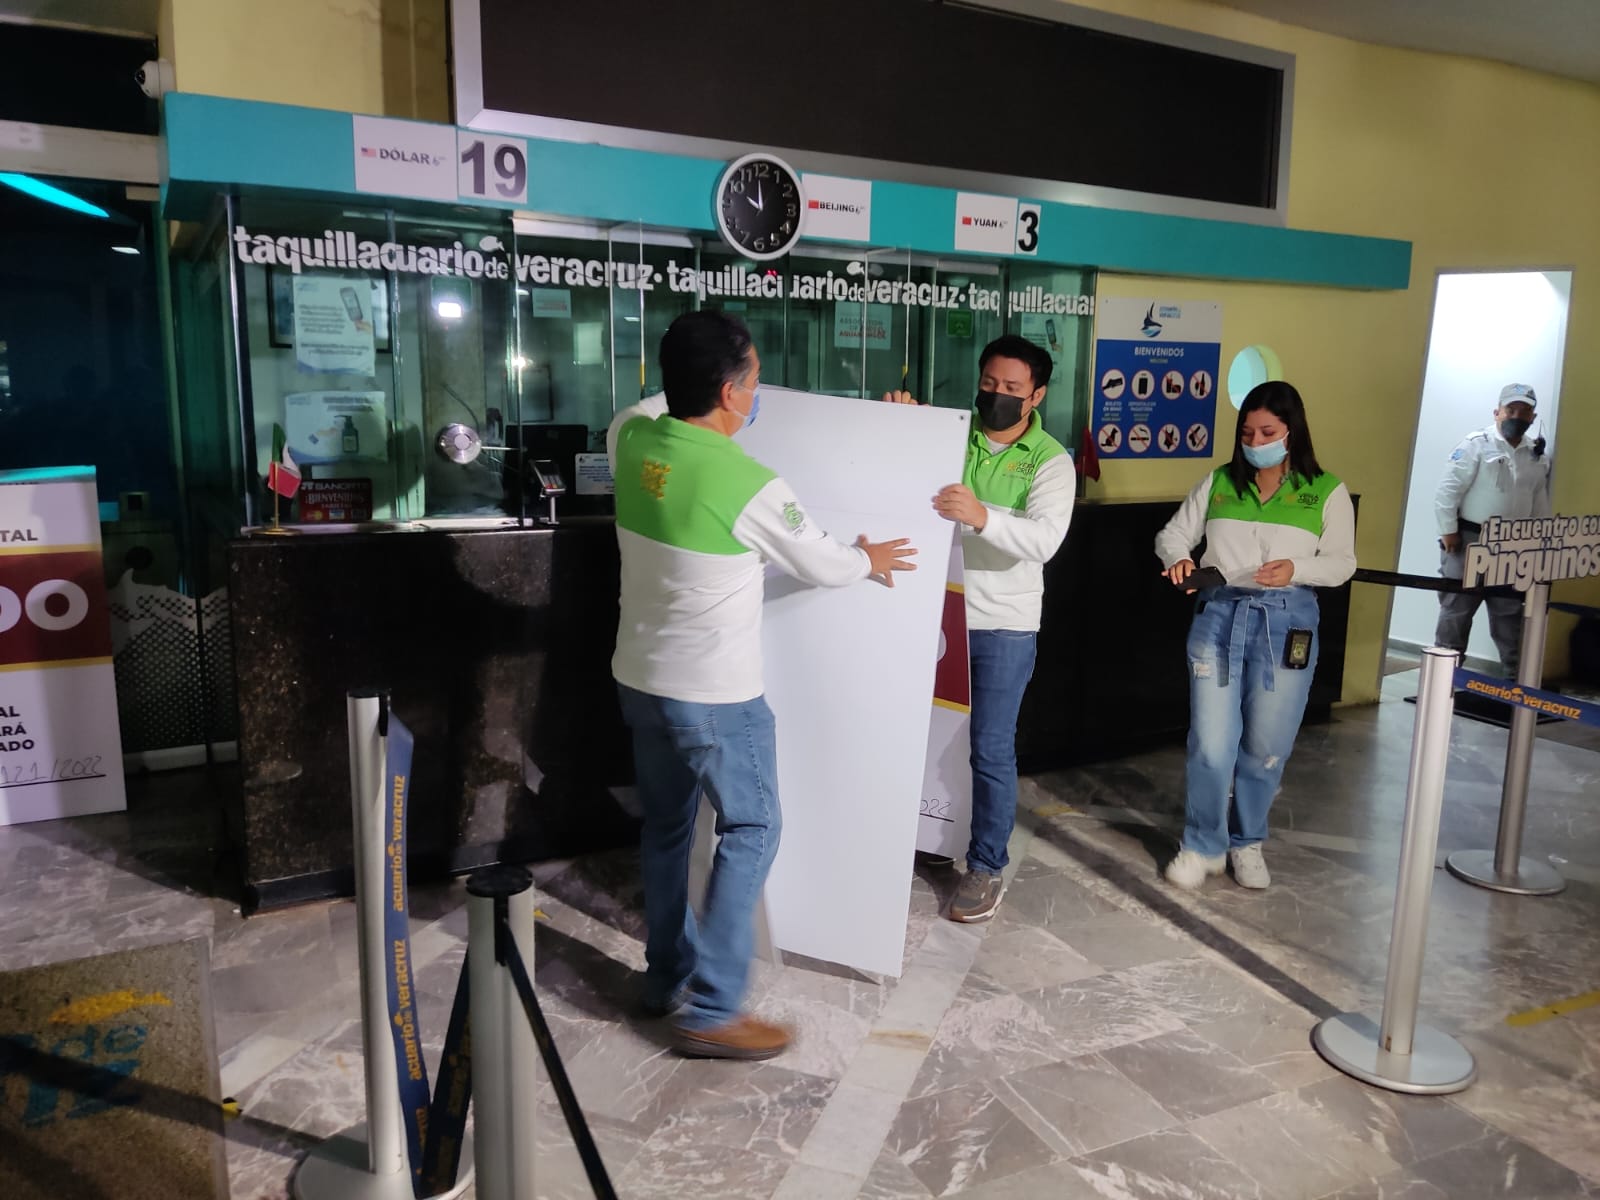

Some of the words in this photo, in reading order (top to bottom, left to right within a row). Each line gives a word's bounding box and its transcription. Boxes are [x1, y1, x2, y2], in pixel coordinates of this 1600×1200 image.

[379, 147, 430, 166] DÓLAR
[461, 139, 527, 198] 19
[738, 167, 753, 183] 11
[752, 162, 770, 179] 12
[773, 169, 780, 184] 1
[728, 178, 745, 195] 10
[782, 183, 793, 199] 2
[786, 203, 797, 218] 3
[819, 200, 855, 213] BEIJING
[779, 220, 791, 235] 4
[973, 217, 998, 228] YUAN
[1018, 210, 1039, 252] 3
[753, 236, 765, 251] 6
[1134, 346, 1185, 358] BIENVENIDOS
[1466, 679, 1512, 700] acuario
[1522, 693, 1583, 720] veracruz
[0, 721, 27, 737] RÁ
[392, 775, 406, 841] veracruz
[391, 855, 405, 913] acuario
[394, 939, 412, 1009] veracruz
[401, 1023, 423, 1081] acuario
